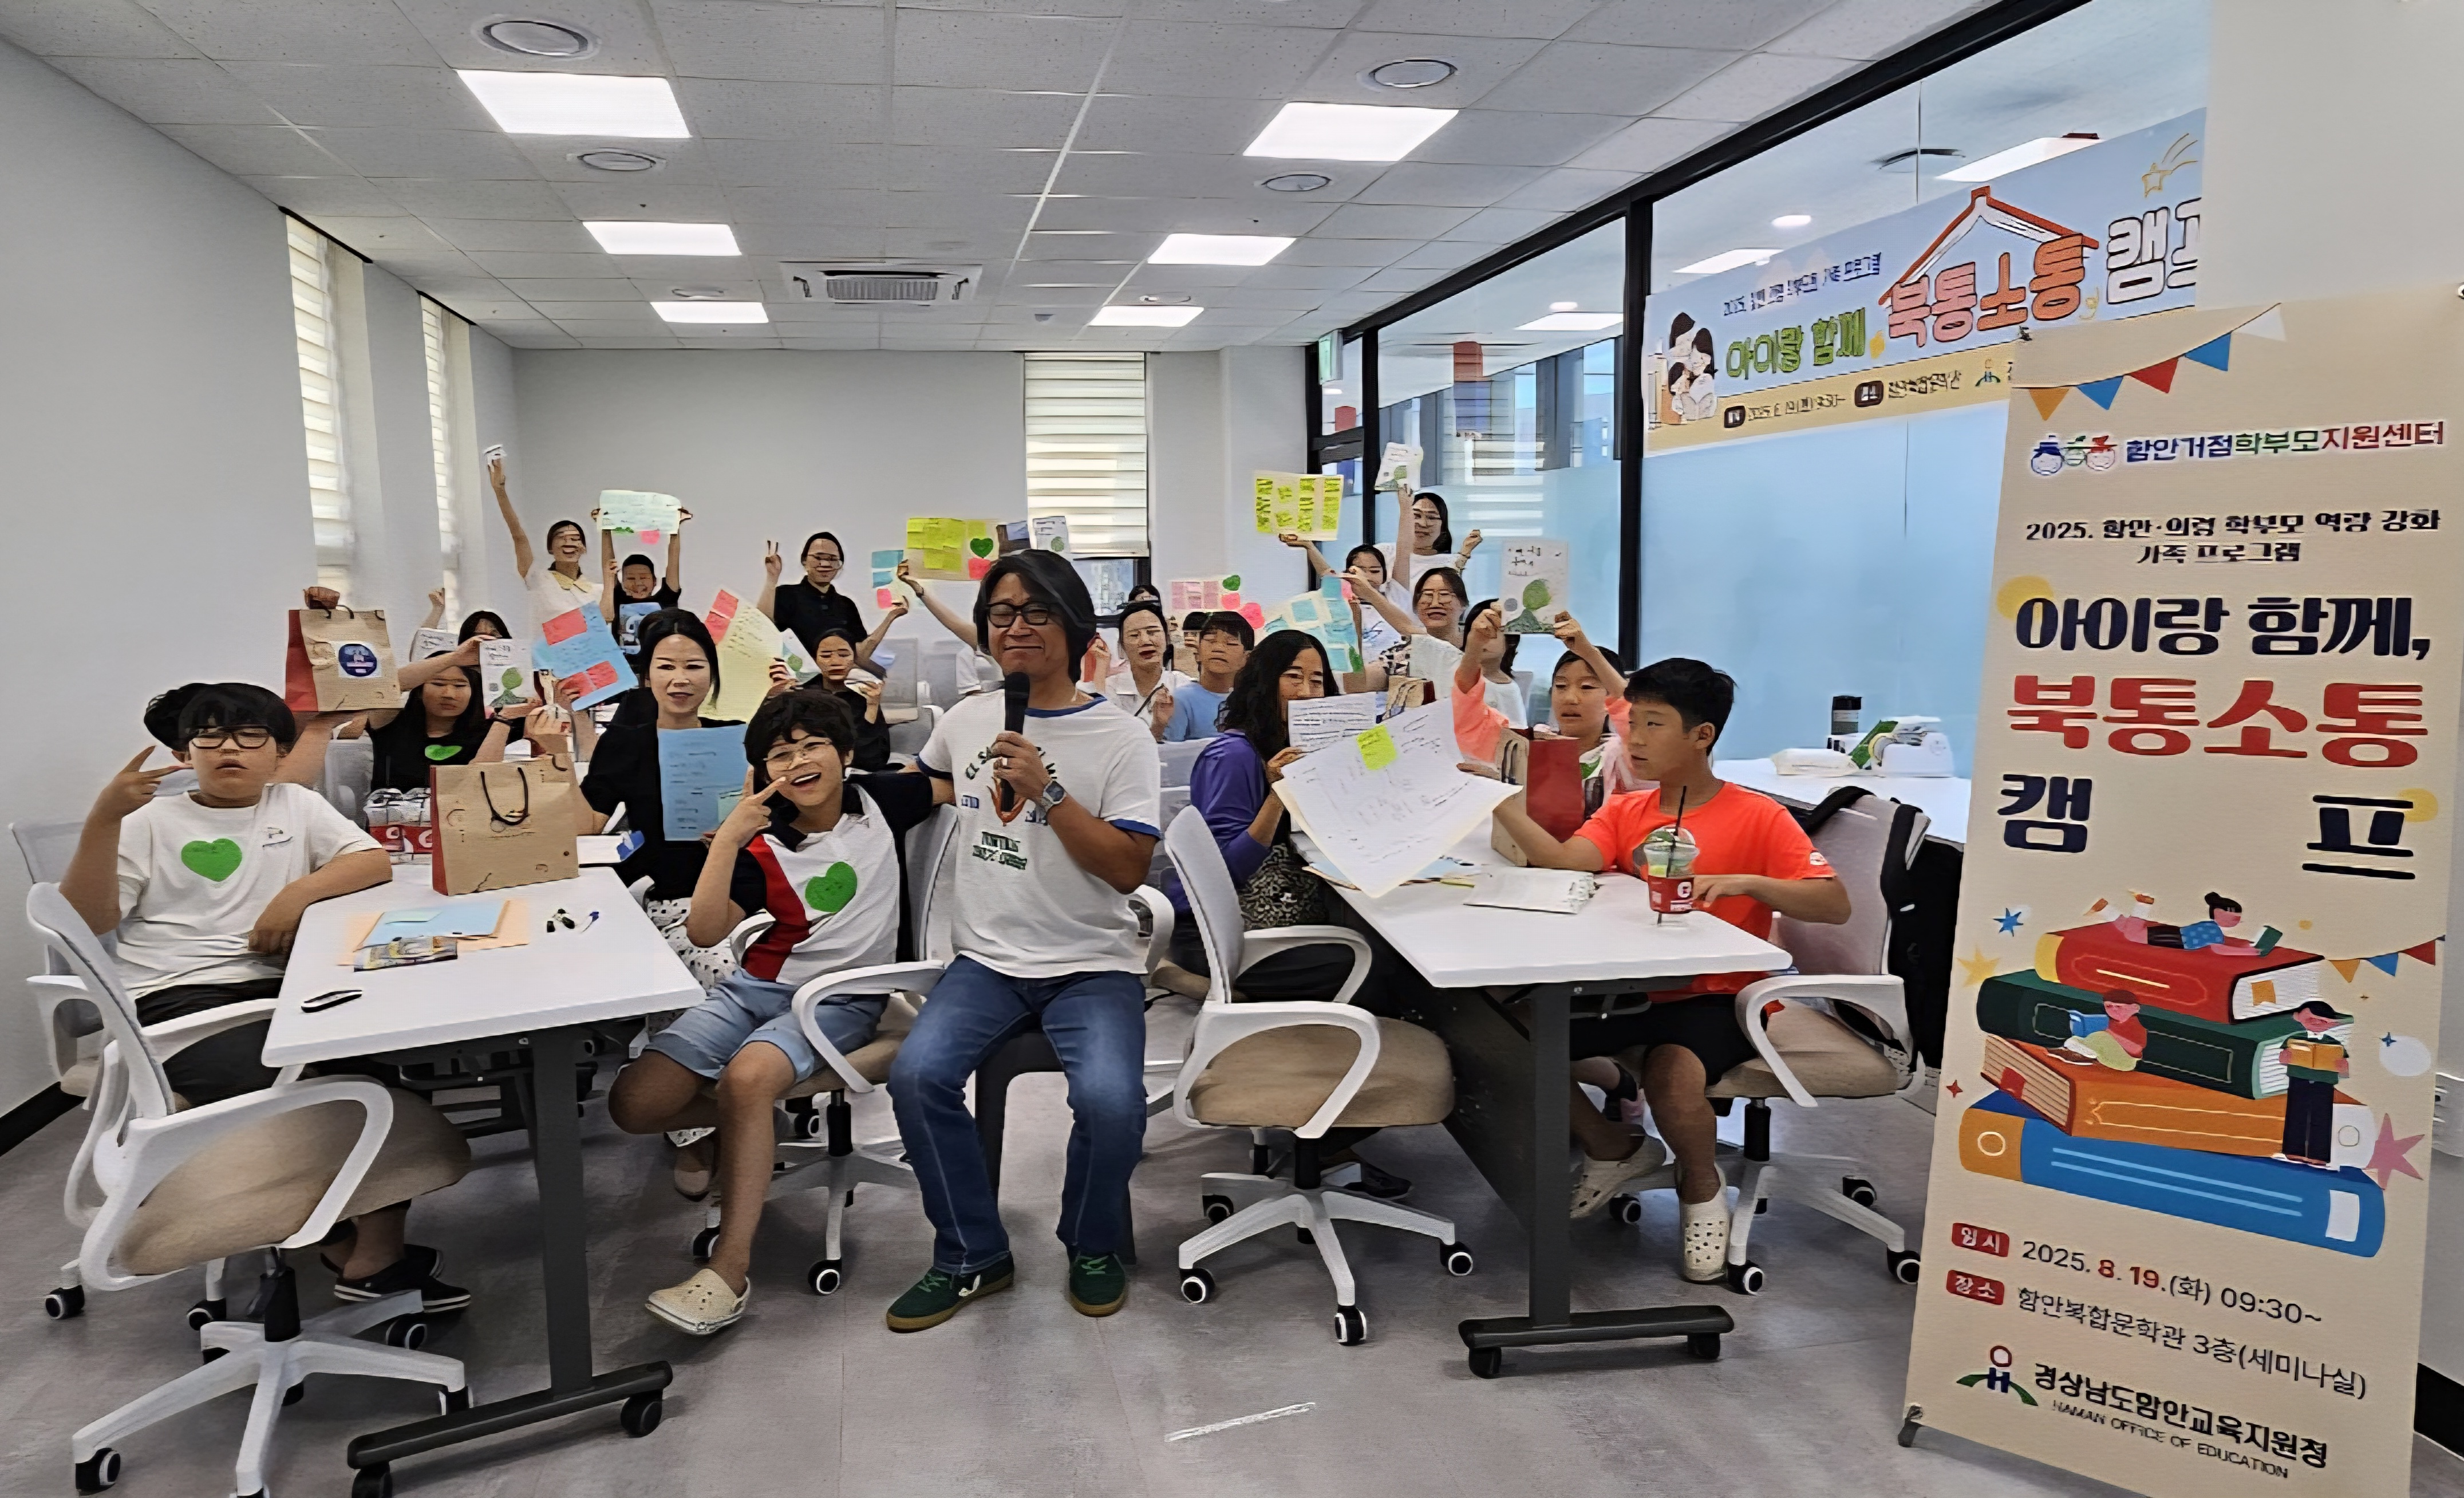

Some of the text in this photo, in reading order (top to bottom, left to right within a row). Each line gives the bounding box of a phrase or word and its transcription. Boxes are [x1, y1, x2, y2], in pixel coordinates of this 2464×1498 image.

[1726, 325, 1804, 380] 아이랑
[1889, 232, 2086, 348] 북통소통
[2126, 421, 2444, 463] 함안거점학부모지원센터
[2026, 522, 2093, 540] 2025.
[2225, 515, 2304, 534] 학부모
[2382, 508, 2442, 532] 강화
[2137, 542, 2301, 564] 가족 프로그램
[2016, 597, 2431, 660] 아이랑 함께,
[2007, 675, 2429, 768] 북통소통
[2221, 1287, 2321, 1324] 09:30~
[2193, 1334, 2366, 1400] 3층(세미나실)
[2170, 1435, 2193, 1449] OF
[2197, 1442, 2288, 1479] EDUCATION
